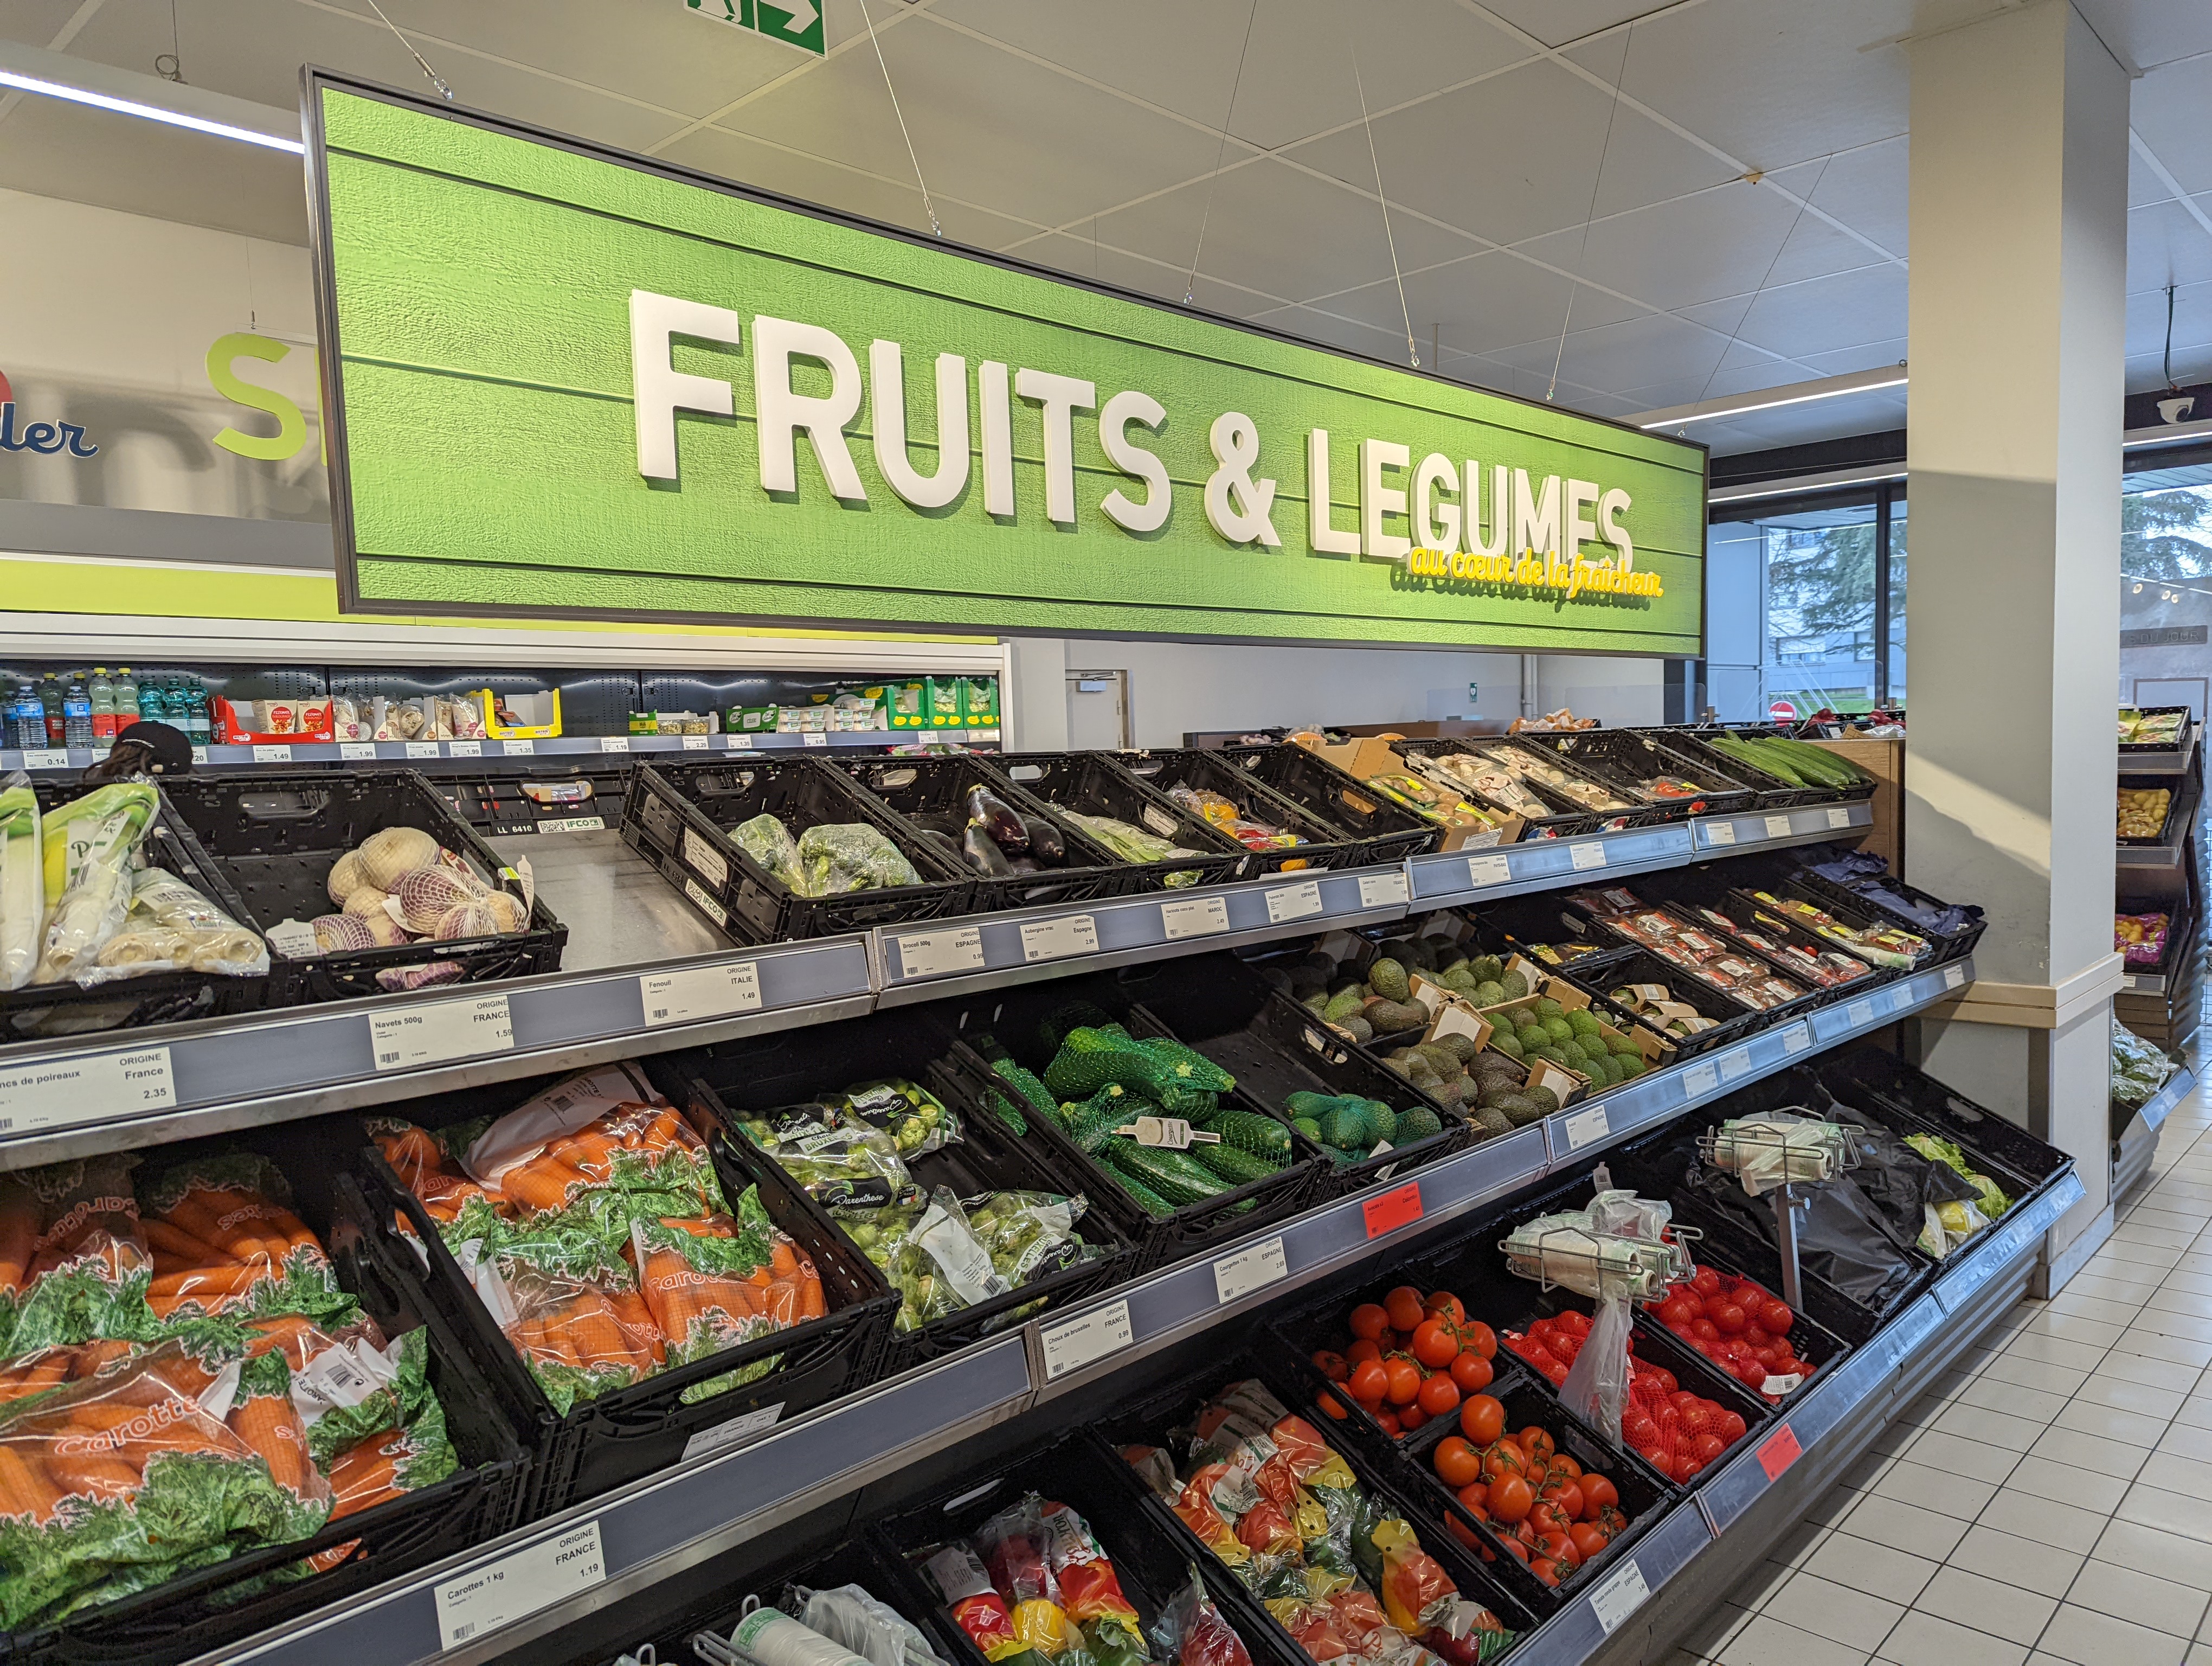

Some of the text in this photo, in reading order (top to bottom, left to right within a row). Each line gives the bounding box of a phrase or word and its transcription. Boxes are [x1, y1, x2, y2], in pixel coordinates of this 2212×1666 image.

[629, 289, 1633, 575] FRUITS & LEGUMES
[1409, 546, 1448, 576] au
[1515, 547, 1545, 588] de
[1545, 549, 1571, 589] la
[1567, 553, 1664, 599] fraîcheur
[2140, 631, 2199, 644] DU JOUR
[512, 824, 532, 833] 6410
[565, 819, 589, 829] IFCO
[1301, 890, 1317, 898] ESPAGNE
[702, 895, 717, 914] IFCO
[955, 938, 982, 948] ESPAGNE
[726, 965, 751, 975] ORIGINE
[648, 979, 672, 989] Fenouil
[731, 975, 754, 985] ITALIE
[742, 992, 756, 1000] 1.49
[477, 998, 508, 1010] ORIGINE
[375, 1016, 423, 1029] Navets 500g
[473, 1010, 510, 1023] FRANCE
[495, 1028, 513, 1039] 1.59
[119, 1053, 162, 1066] ORIGINE
[21, 1076, 34, 1086] de
[36, 1070, 81, 1085] poireaux
[125, 1067, 164, 1080] France
[143, 1087, 167, 1099] 2.35
[1265, 1238, 1281, 1248] ORIGINE
[1262, 1246, 1282, 1260] ESPAGNE
[1219, 1259, 1240, 1272] Courgettes
[1106, 1304, 1126, 1317] ORIGINE
[1104, 1313, 1127, 1329] FRANCE
[1048, 1335, 1064, 1344] Choux
[1070, 1322, 1091, 1336] bruxelles
[1118, 1329, 1129, 1339] 0.99
[559, 1527, 594, 1548] ORIGINE
[555, 1541, 596, 1566] FRANCE
[580, 1563, 599, 1578] 1.19
[1624, 1562, 1635, 1574] ORIGINE
[1624, 1569, 1639, 1586] ESPAGNE
[447, 1571, 504, 1600] Carottes 1 kg
[1594, 1580, 1621, 1605] Tomate ronde grappe
